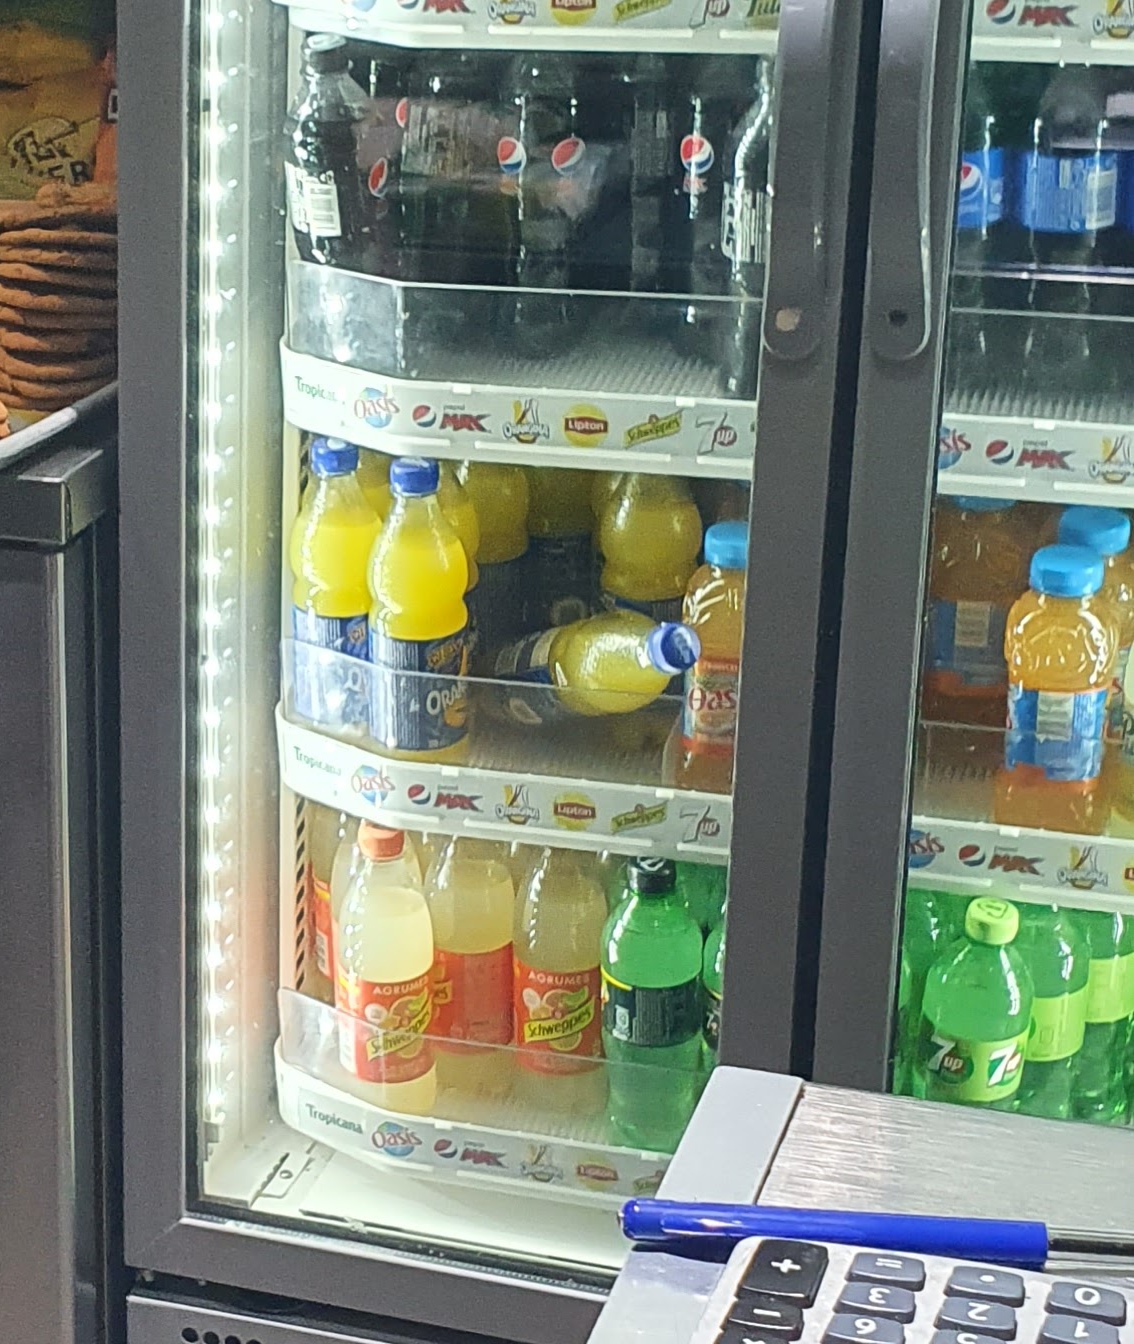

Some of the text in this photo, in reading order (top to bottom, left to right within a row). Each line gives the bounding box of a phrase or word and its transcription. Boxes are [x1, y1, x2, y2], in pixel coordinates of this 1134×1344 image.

[353, 388, 401, 420] Oasis
[568, 419, 605, 433] Lipton
[351, 770, 396, 796] Oasis
[556, 806, 595, 819] Lipton
[372, 975, 429, 996] AGRUMES
[527, 970, 591, 985] AGRUMES
[527, 1007, 592, 1038] Schweppes
[305, 1103, 363, 1135] Tropicana
[371, 1127, 423, 1150] Oasis
